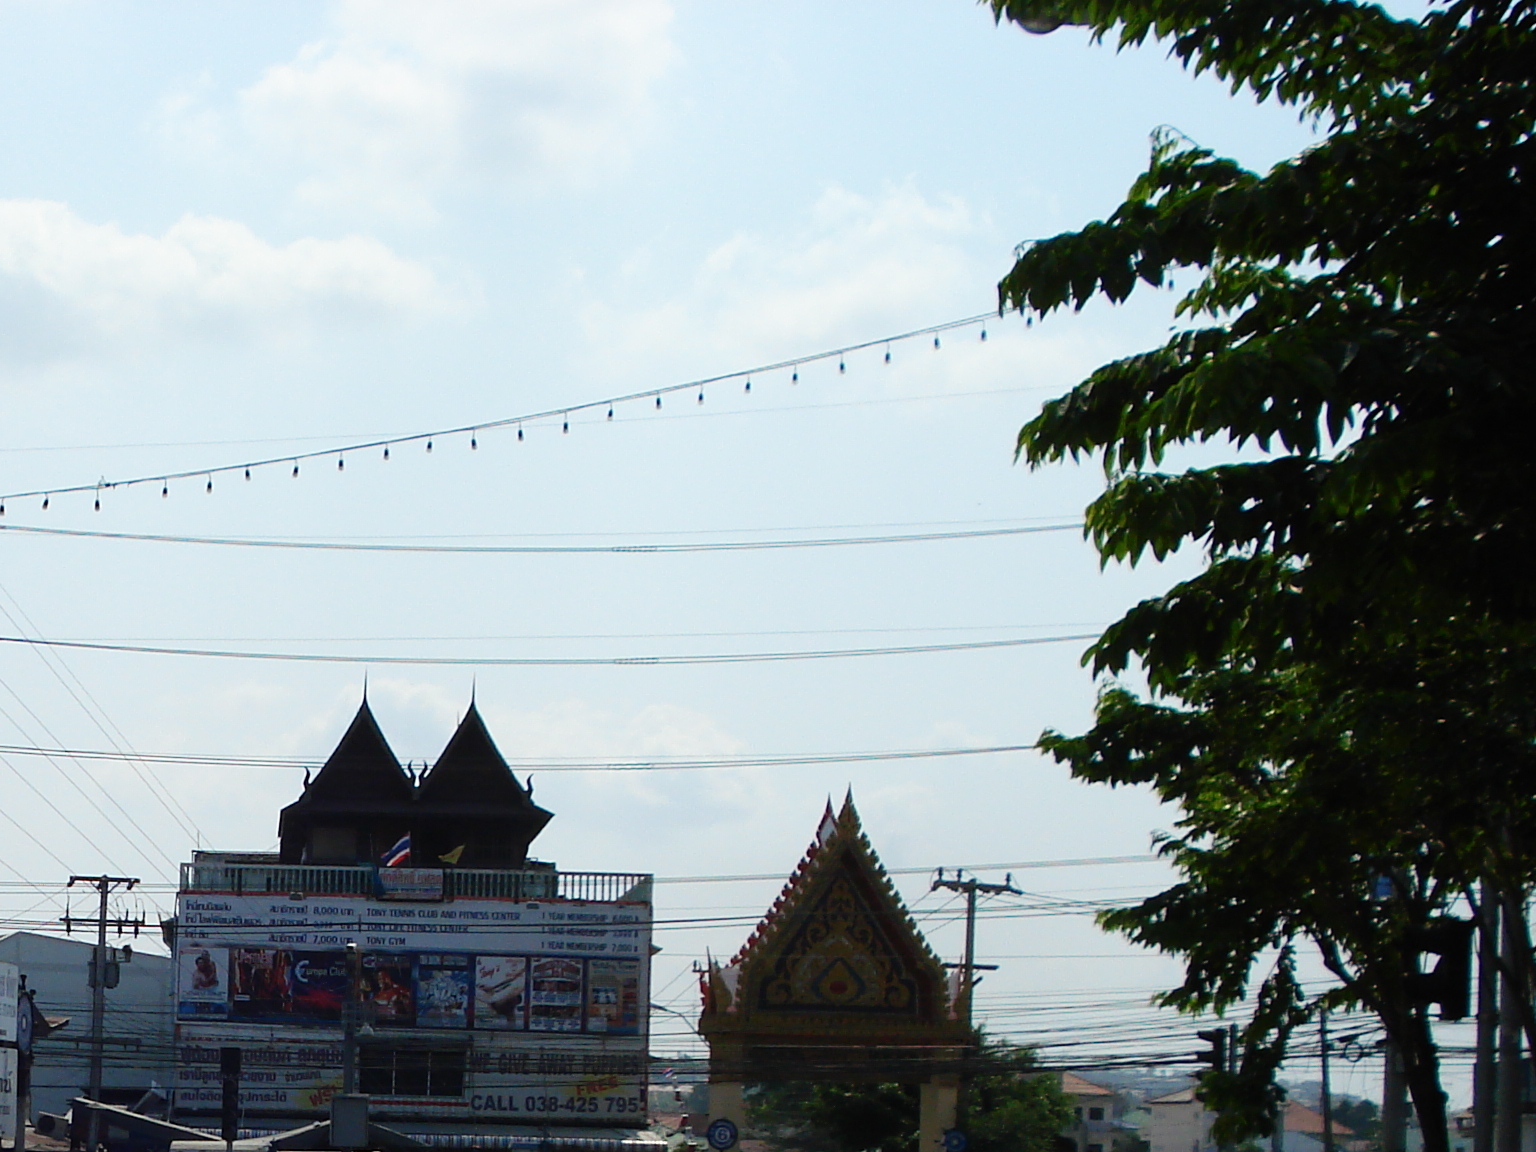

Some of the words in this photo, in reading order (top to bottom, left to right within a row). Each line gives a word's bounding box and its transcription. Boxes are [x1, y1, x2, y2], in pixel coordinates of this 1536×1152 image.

[366, 908, 387, 917] TONY
[389, 909, 416, 918] TENNIS
[418, 909, 438, 918] CLUB
[440, 910, 457, 919] AND
[459, 911, 489, 920] FITNESS
[491, 912, 521, 921] CENTER
[366, 937, 386, 945] TONY
[388, 938, 406, 946] GYM
[471, 1095, 519, 1112] CALL
[525, 1096, 599, 1113] 038-425
[605, 1097, 638, 1113] 795
